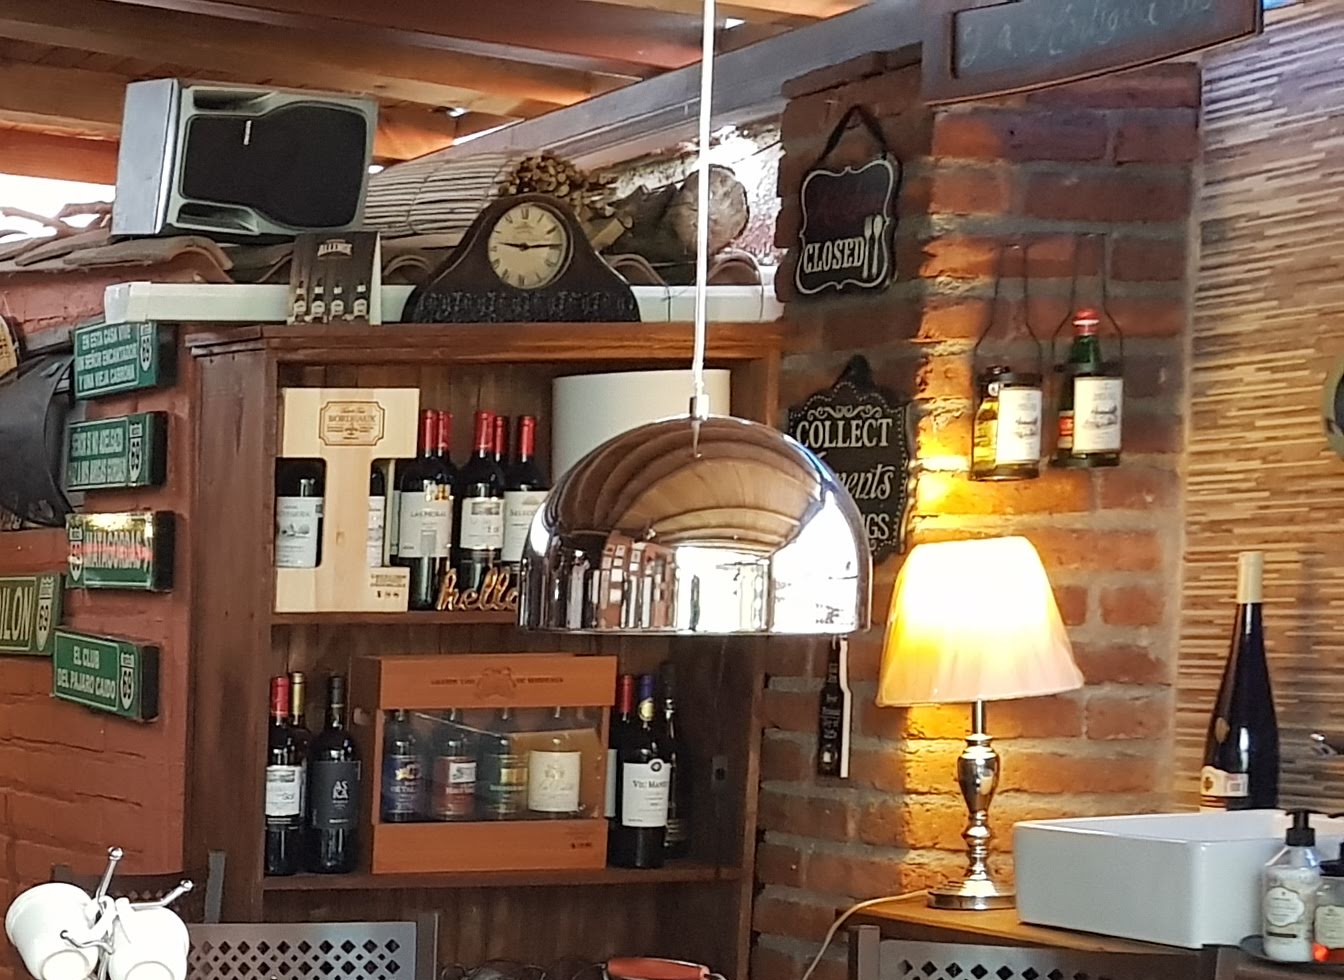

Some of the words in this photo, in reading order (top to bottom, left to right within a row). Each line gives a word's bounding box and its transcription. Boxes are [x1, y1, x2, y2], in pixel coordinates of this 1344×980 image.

[803, 237, 865, 273] CLOSED
[796, 418, 892, 449] COLLECT
[837, 463, 896, 500] ents
[73, 645, 82, 666] EL
[82, 648, 100, 670] CLUB
[57, 668, 69, 688] DEL
[70, 670, 94, 694] PAJARO
